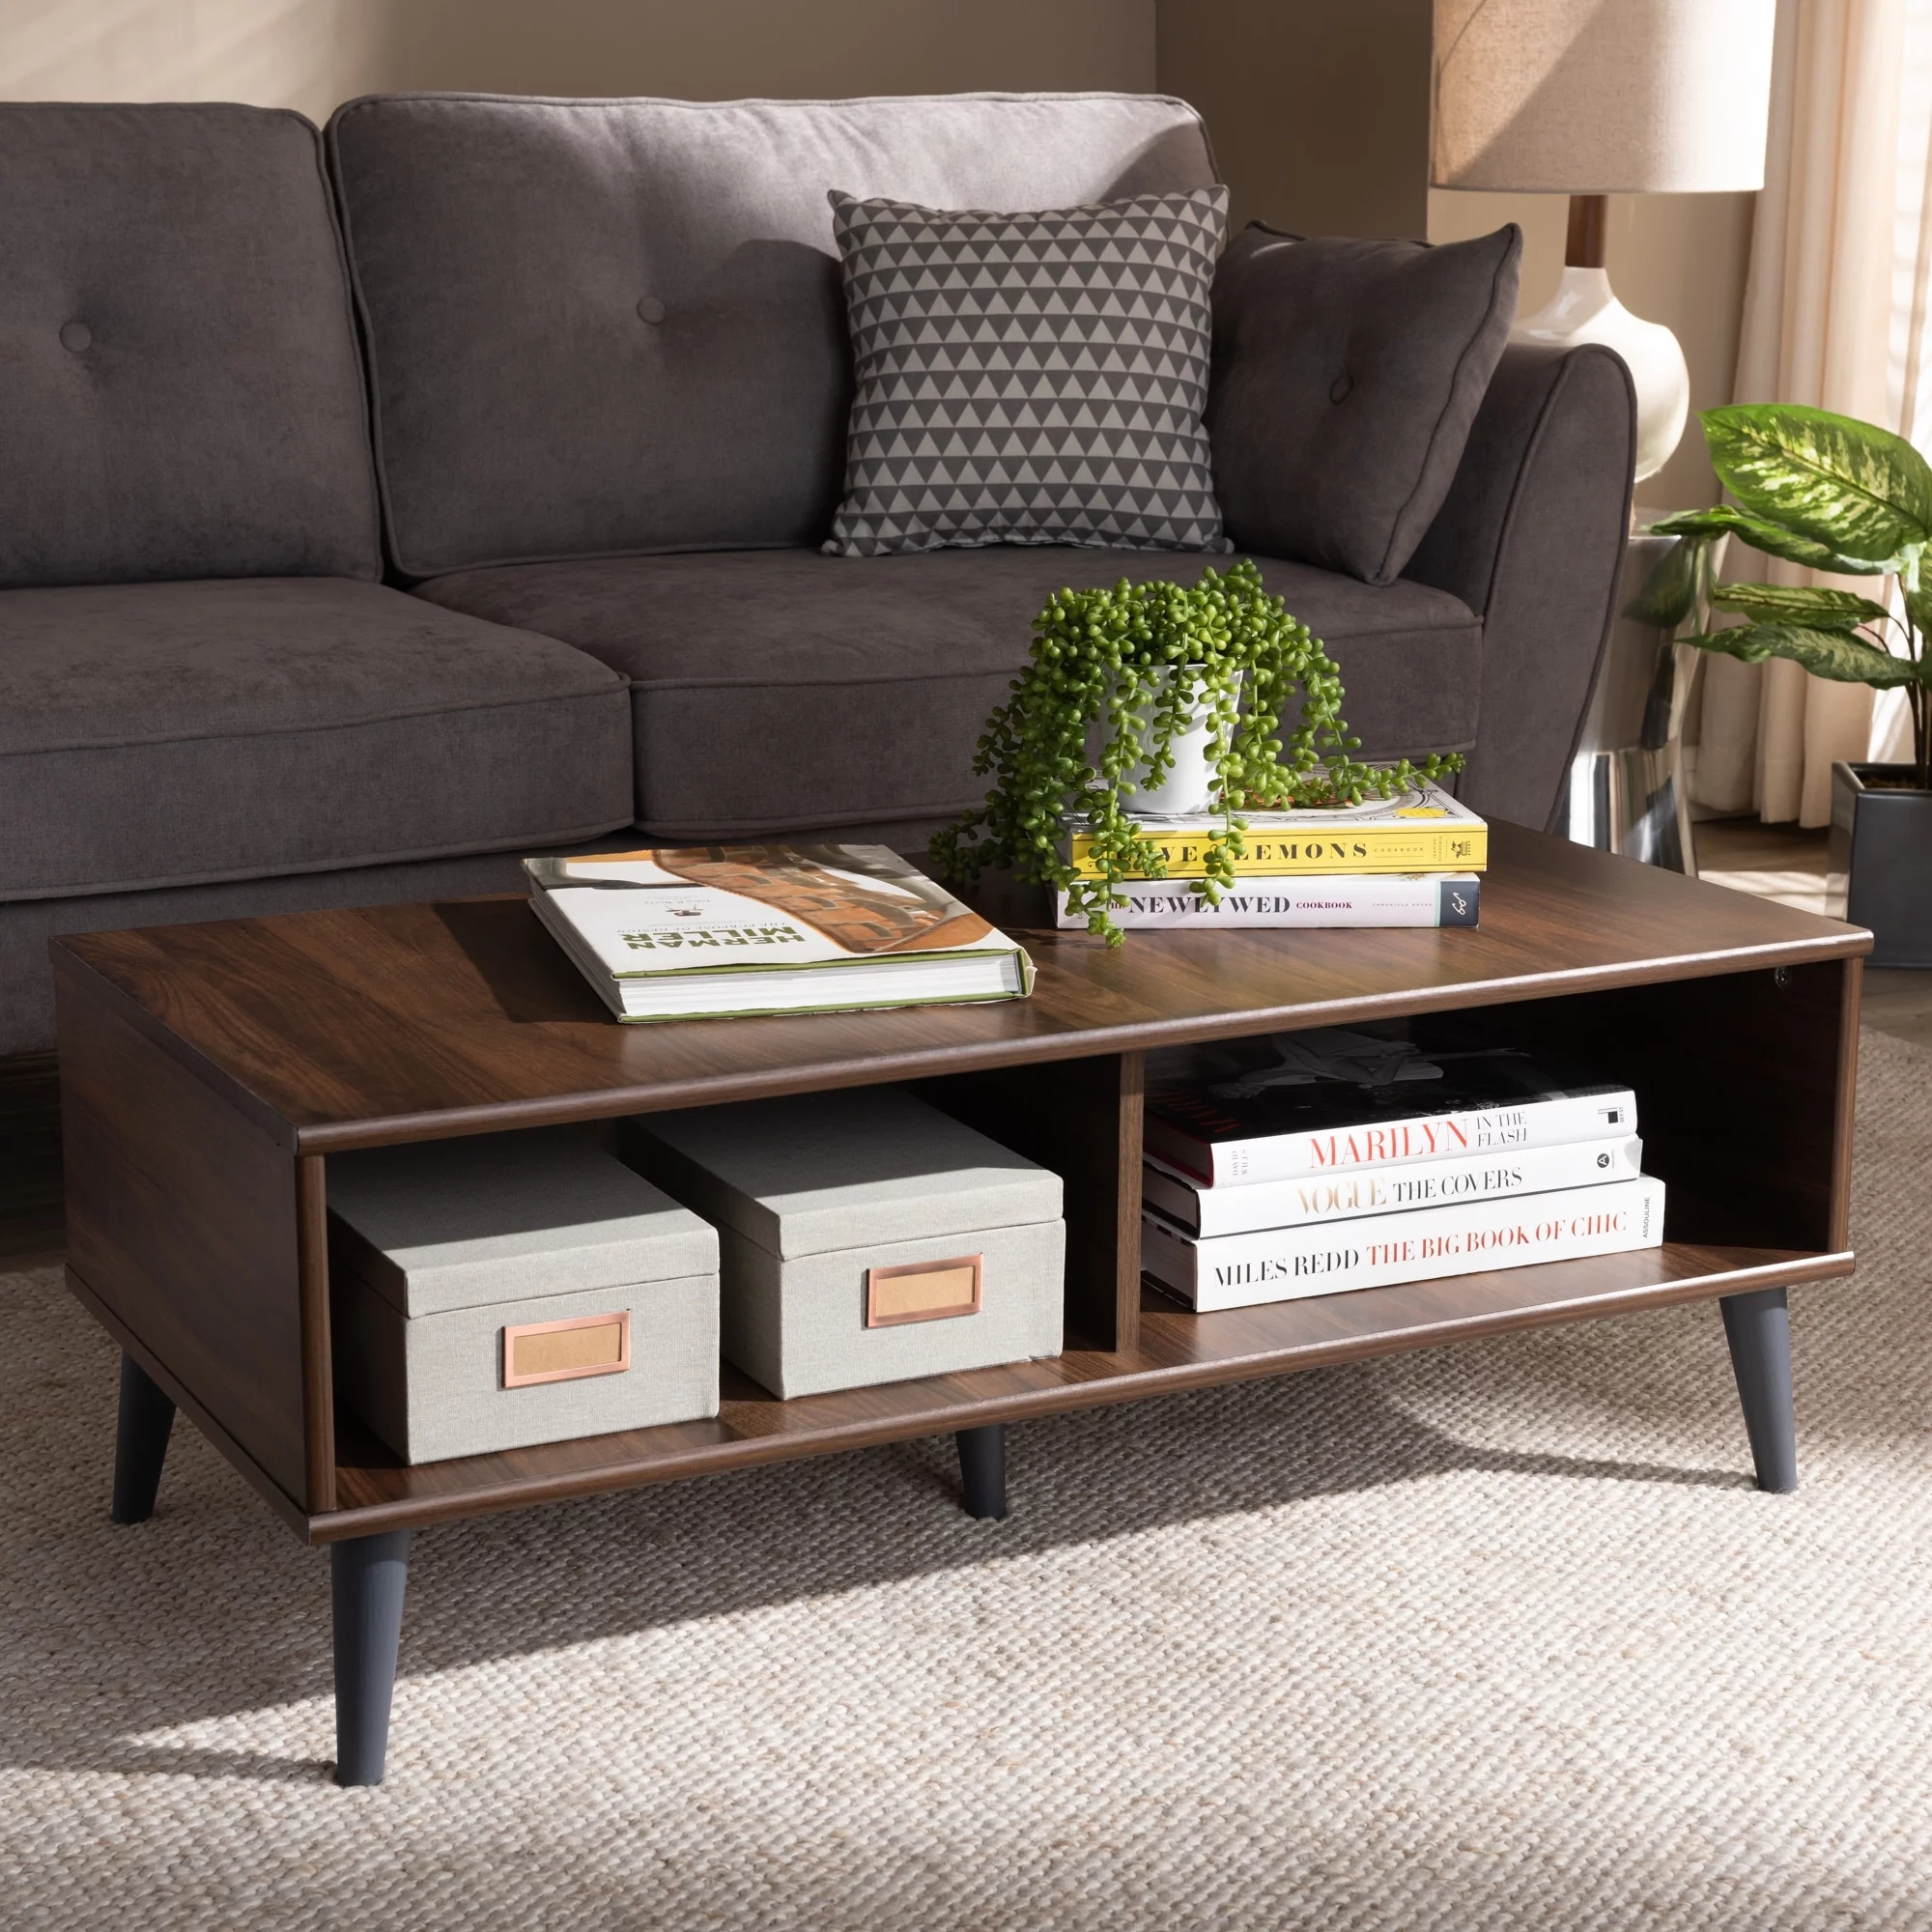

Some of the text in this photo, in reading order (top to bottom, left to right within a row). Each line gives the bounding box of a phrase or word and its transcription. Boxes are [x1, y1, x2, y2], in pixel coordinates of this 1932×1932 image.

[619, 926, 797, 941] MILLER
[627, 934, 806, 950] HERMAN
[1308, 1111, 1527, 1169] MARILYN IN THE
[1477, 1128, 1528, 1148] FLASH
[1297, 1166, 1523, 1214] VOGUE THE COVERS
[1642, 1196, 1651, 1238] ASSOULINE
[1214, 1212, 1627, 1287] MILES REDD THE BIG BOOK OF CHIC
